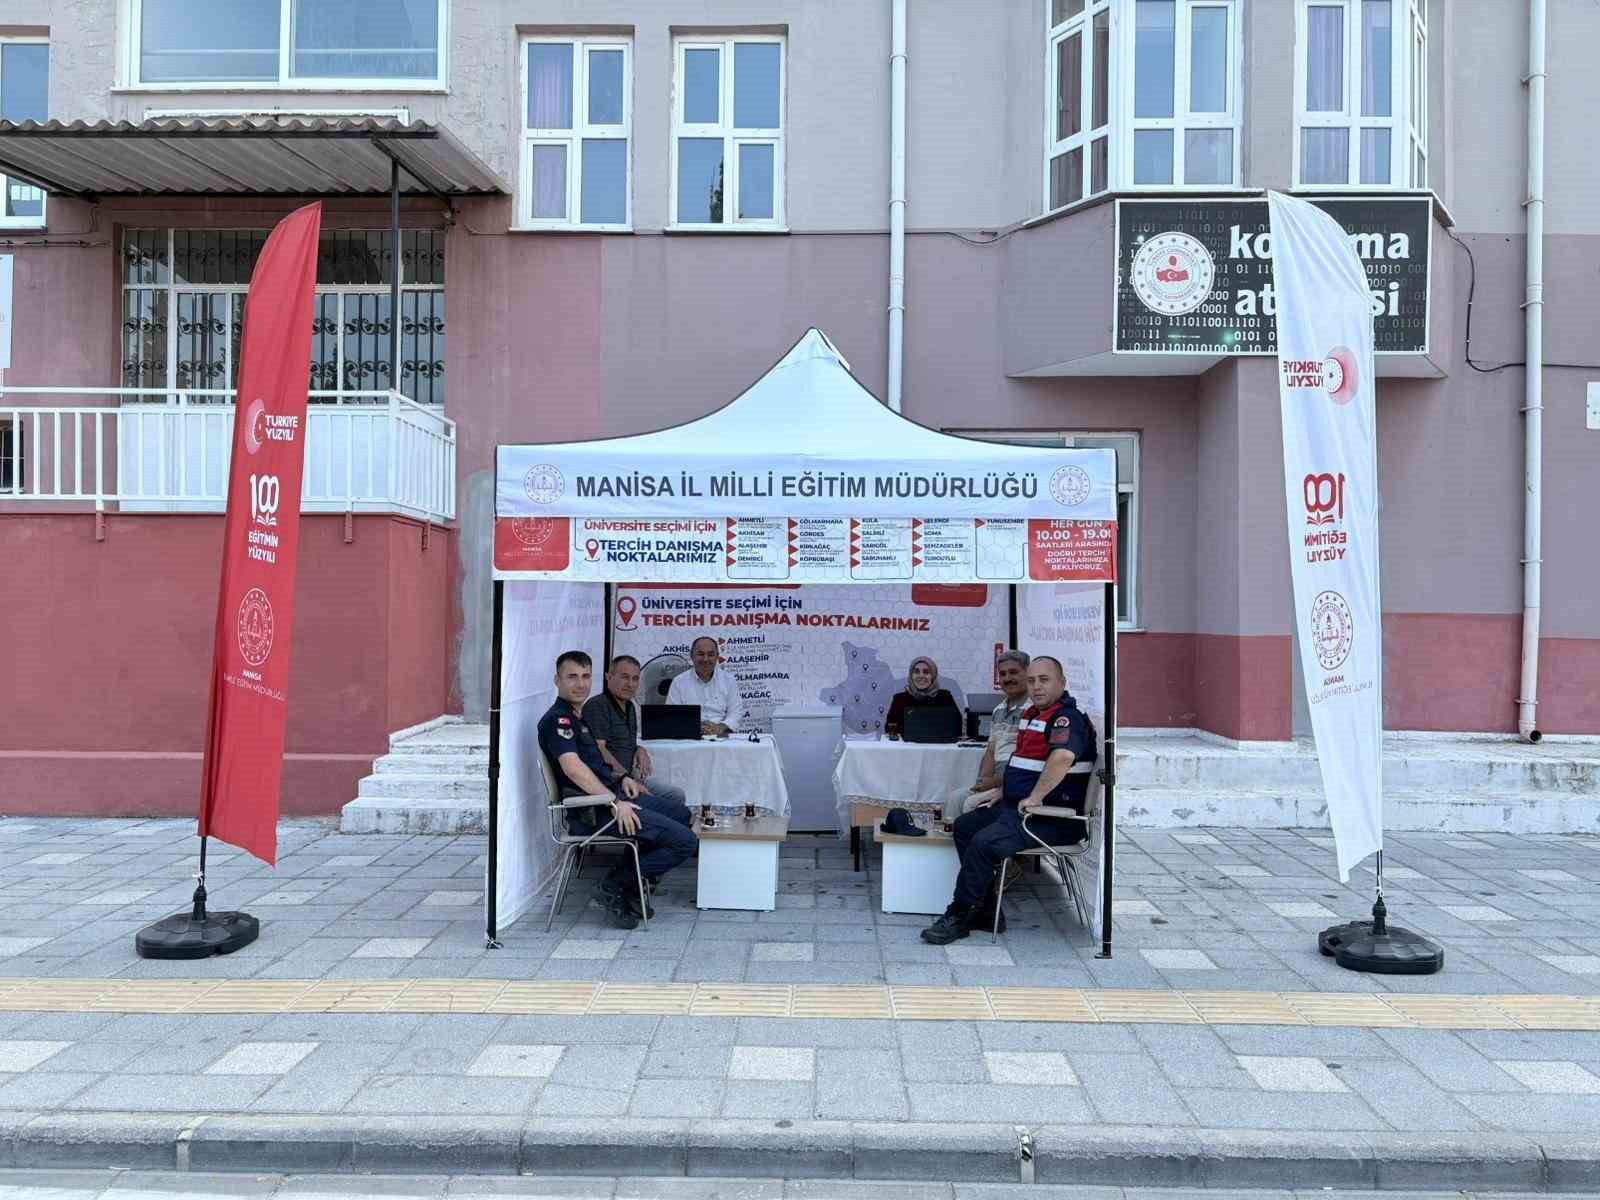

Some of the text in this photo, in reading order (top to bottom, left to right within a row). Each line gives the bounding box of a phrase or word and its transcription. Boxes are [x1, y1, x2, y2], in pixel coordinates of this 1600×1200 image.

[1229, 225, 1410, 259] koma
[1235, 282, 1400, 316] atsi
[576, 471, 1038, 498] MANİSA İL MİLLİ EĞİTİM MÜDÜRLÜĞÜ
[584, 518, 717, 534] ÜNİVERSİTE SEÇİMİ İÇİN
[1051, 520, 1074, 529] HER
[248, 530, 279, 548] EĞİTİMİN
[1035, 530, 1071, 540] 10.00
[599, 537, 651, 551] TERCİH
[656, 539, 724, 554] DANIŞMA
[248, 546, 276, 564] YÜZYILI
[607, 551, 717, 563] NOKTALARIMIZ
[642, 595, 802, 611] ÜNİVERSİTE SEÇİMİ İÇİN
[642, 611, 930, 631] TERCİH DANIŞMA NOKTALARIMIZ
[727, 634, 765, 645] AHMETLİ
[663, 643, 691, 653] AKHİS
[727, 655, 769, 665] ALAŞEHİR
